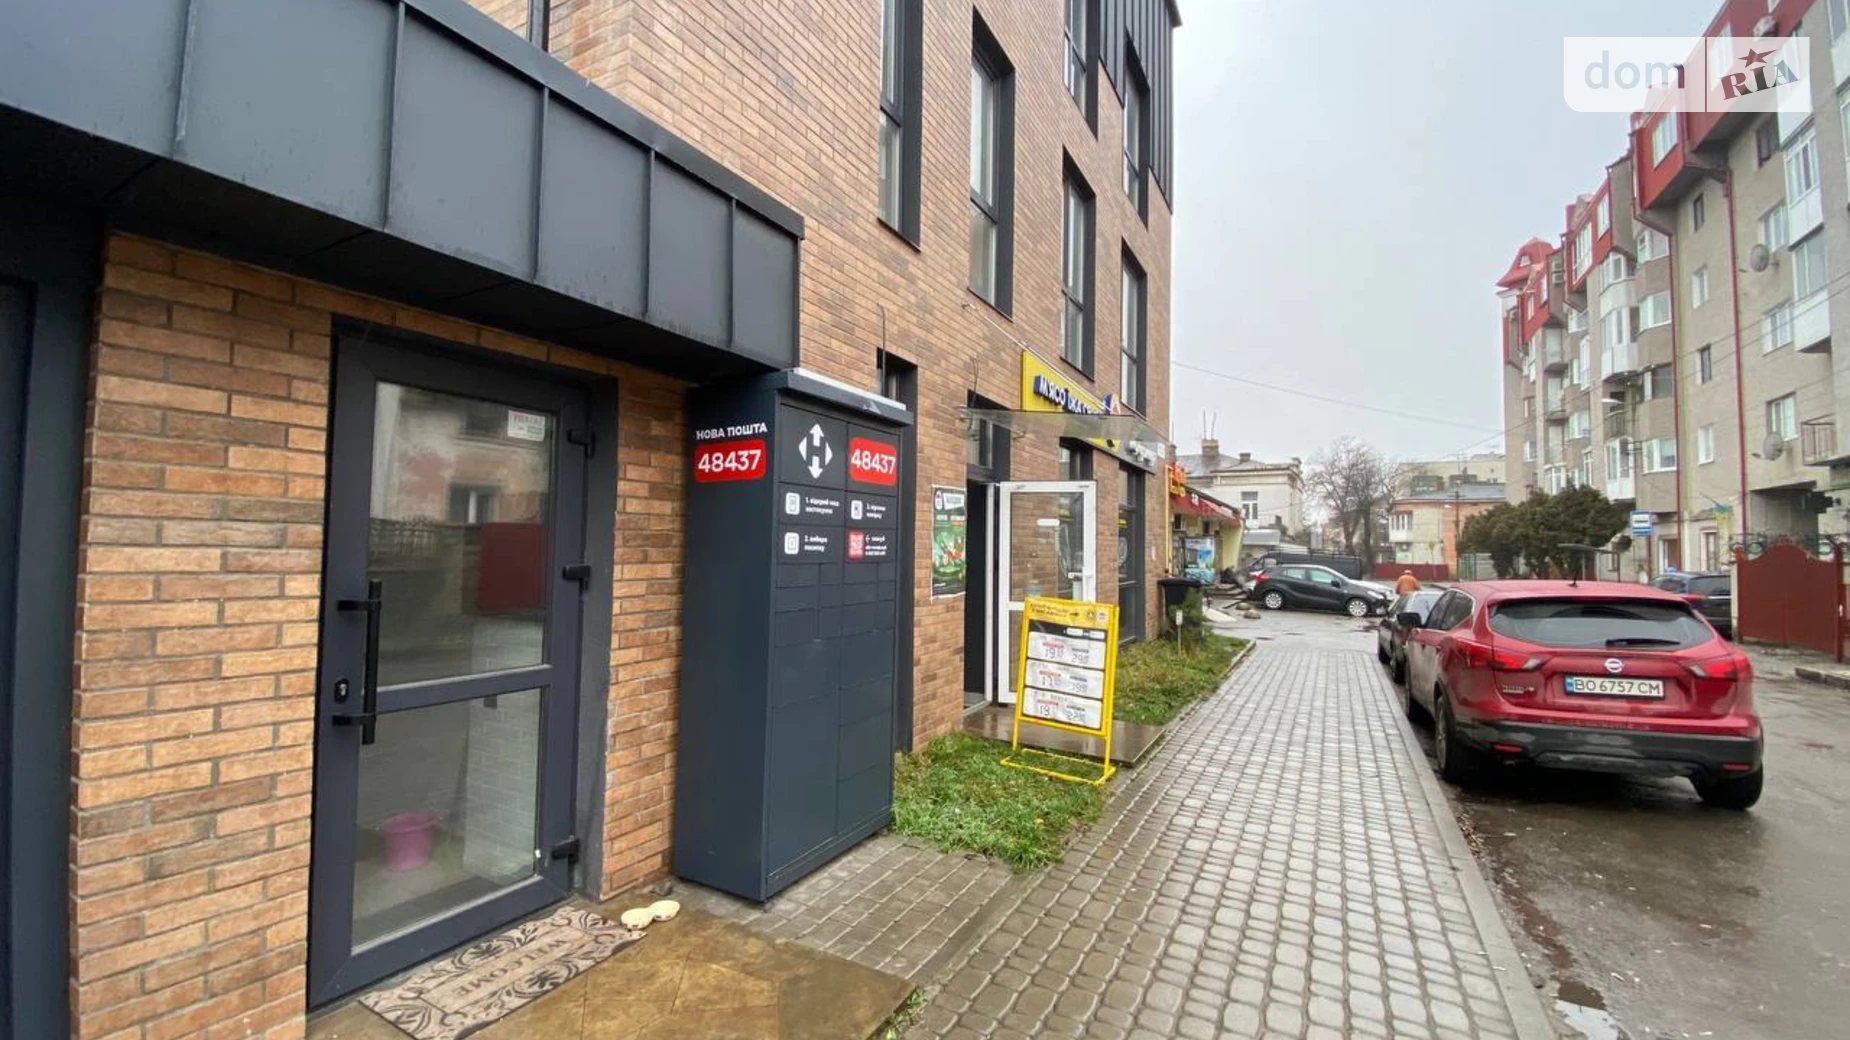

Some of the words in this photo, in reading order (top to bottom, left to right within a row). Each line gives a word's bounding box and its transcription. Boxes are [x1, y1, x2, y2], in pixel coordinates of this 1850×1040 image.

[696, 427, 725, 440] НОВА
[727, 422, 767, 437] ПОШТА
[698, 449, 761, 473] 48437
[851, 448, 896, 475] 48437
[1575, 679, 1596, 691] BO
[1600, 680, 1634, 693] 6757
[1638, 682, 1660, 694] CM
[452, 939, 568, 996] WELCOME
